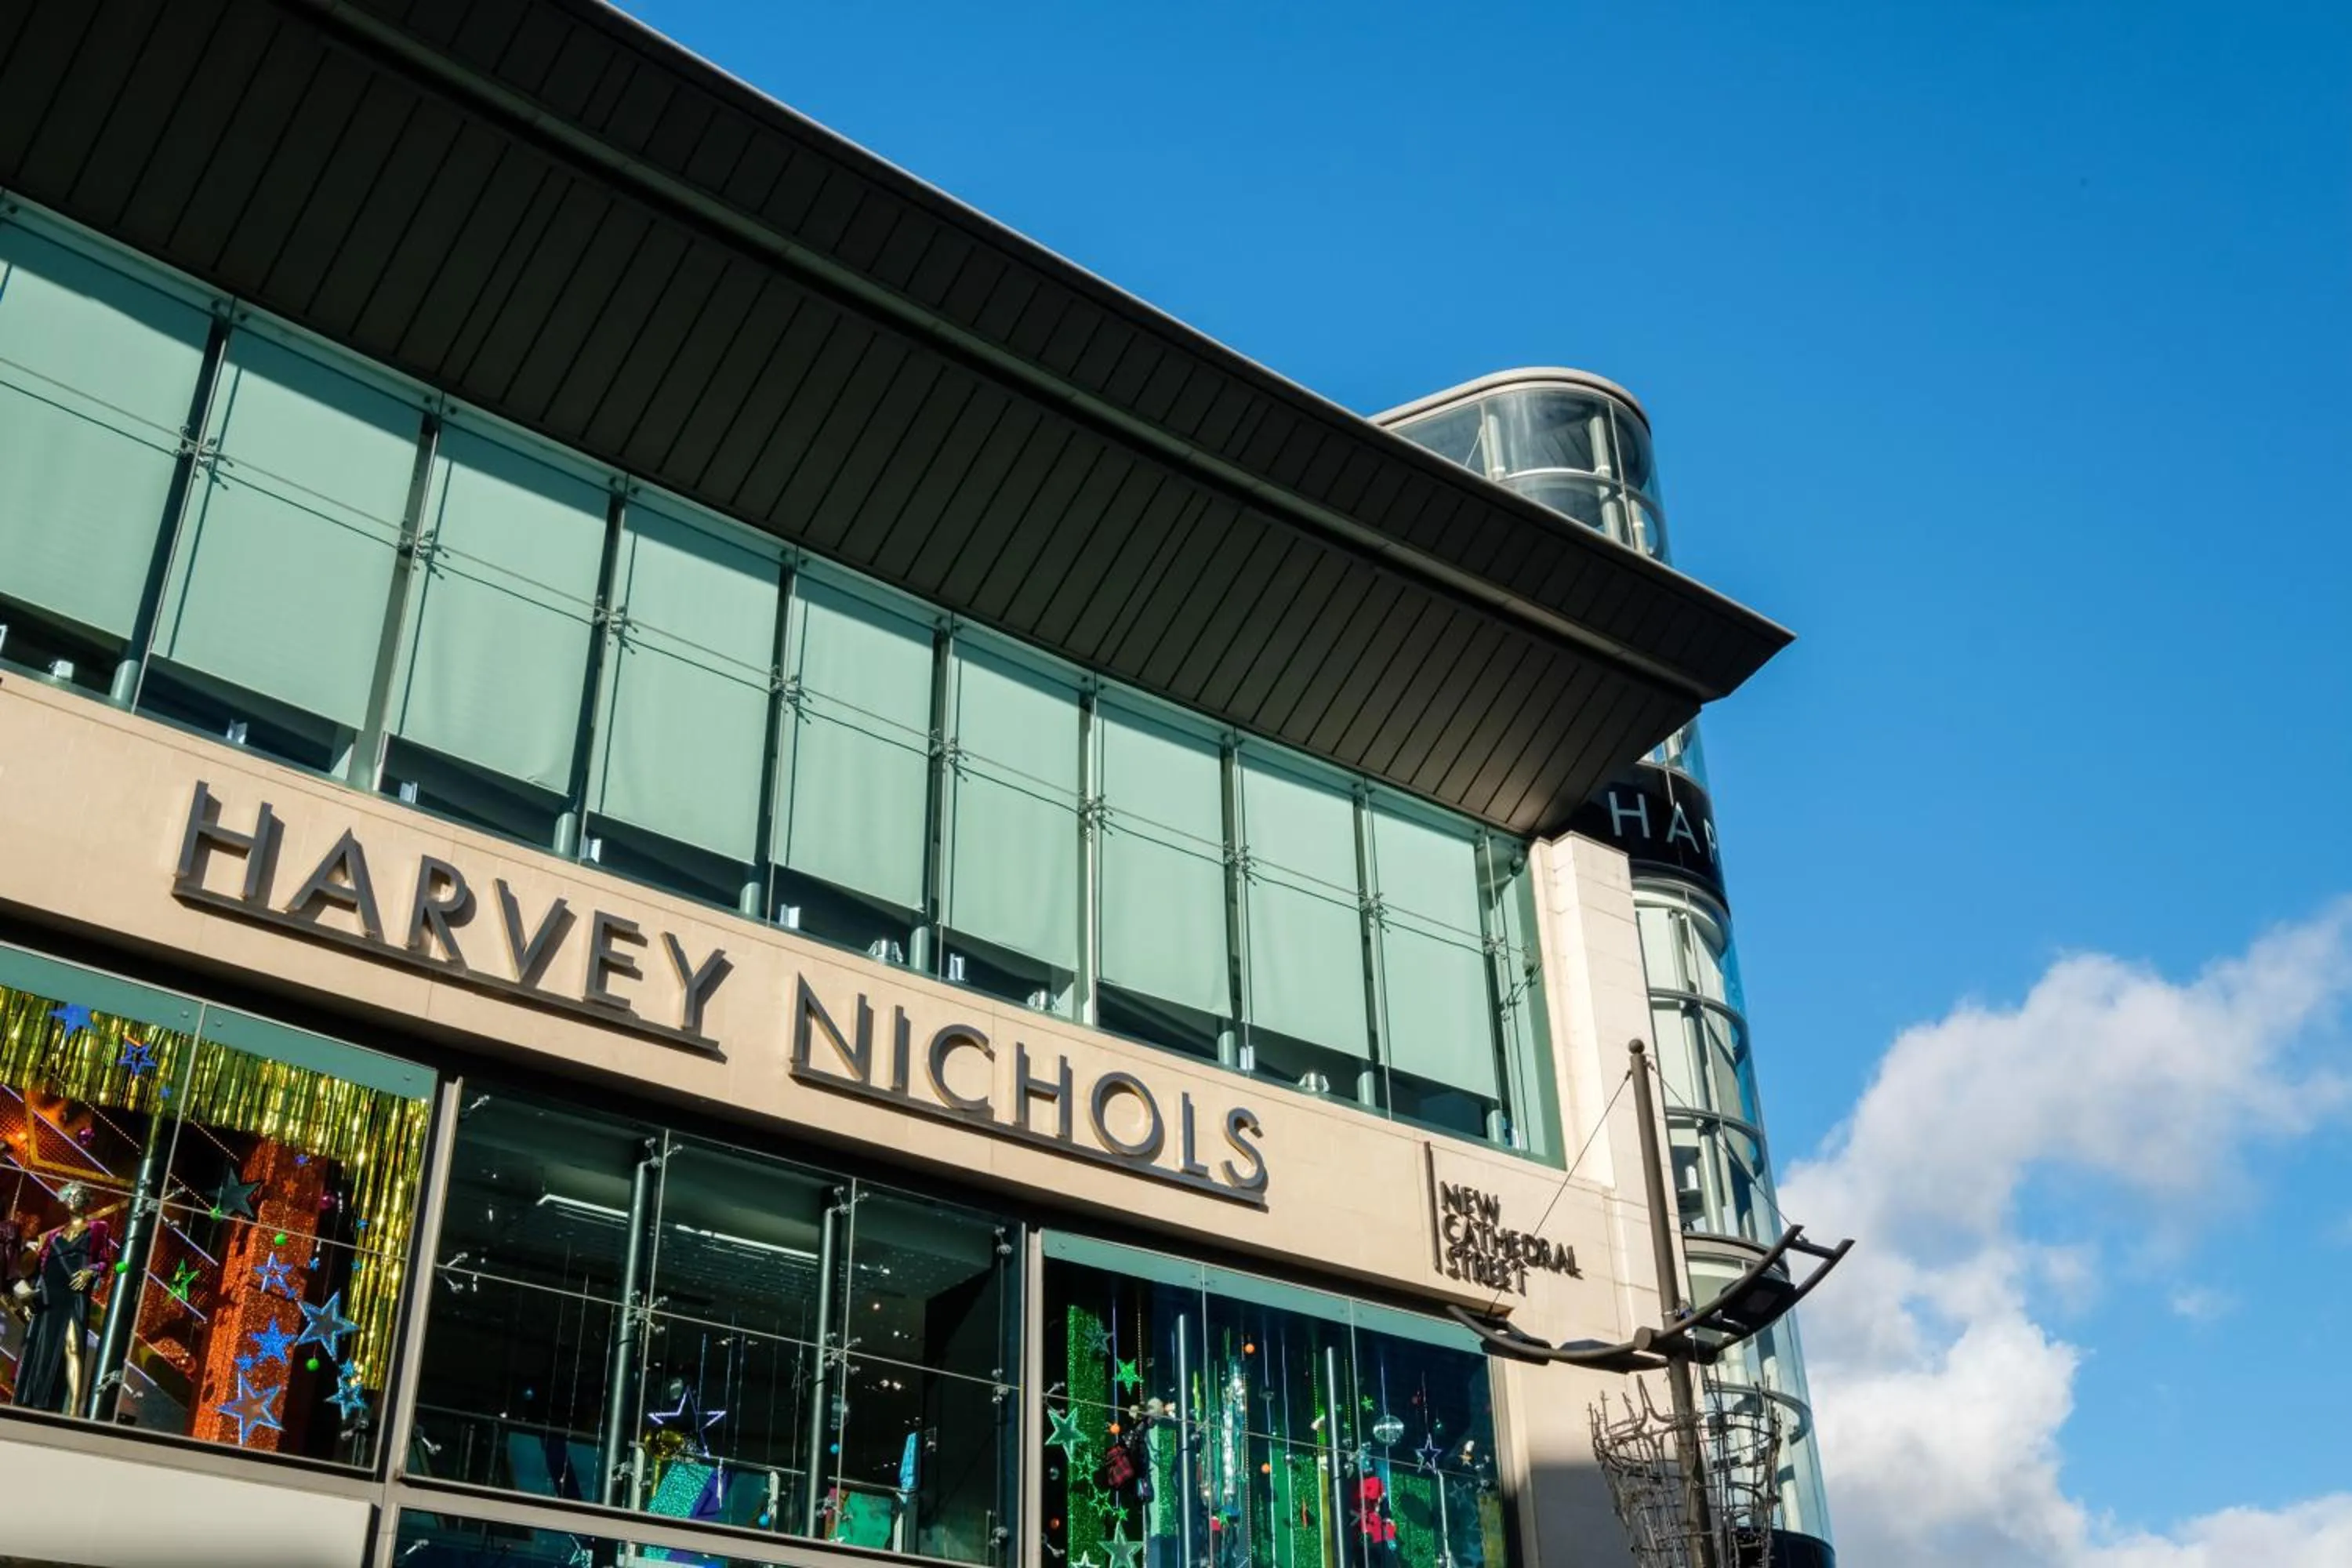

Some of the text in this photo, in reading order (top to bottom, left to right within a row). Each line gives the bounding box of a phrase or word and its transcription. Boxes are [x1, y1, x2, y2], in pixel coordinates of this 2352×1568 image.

[172, 780, 1267, 1190] HARVEY NICHOLS
[1439, 1180, 1501, 1226] NEW
[1442, 1213, 1582, 1279] CATHEDRAL
[1446, 1245, 1527, 1297] STREET
